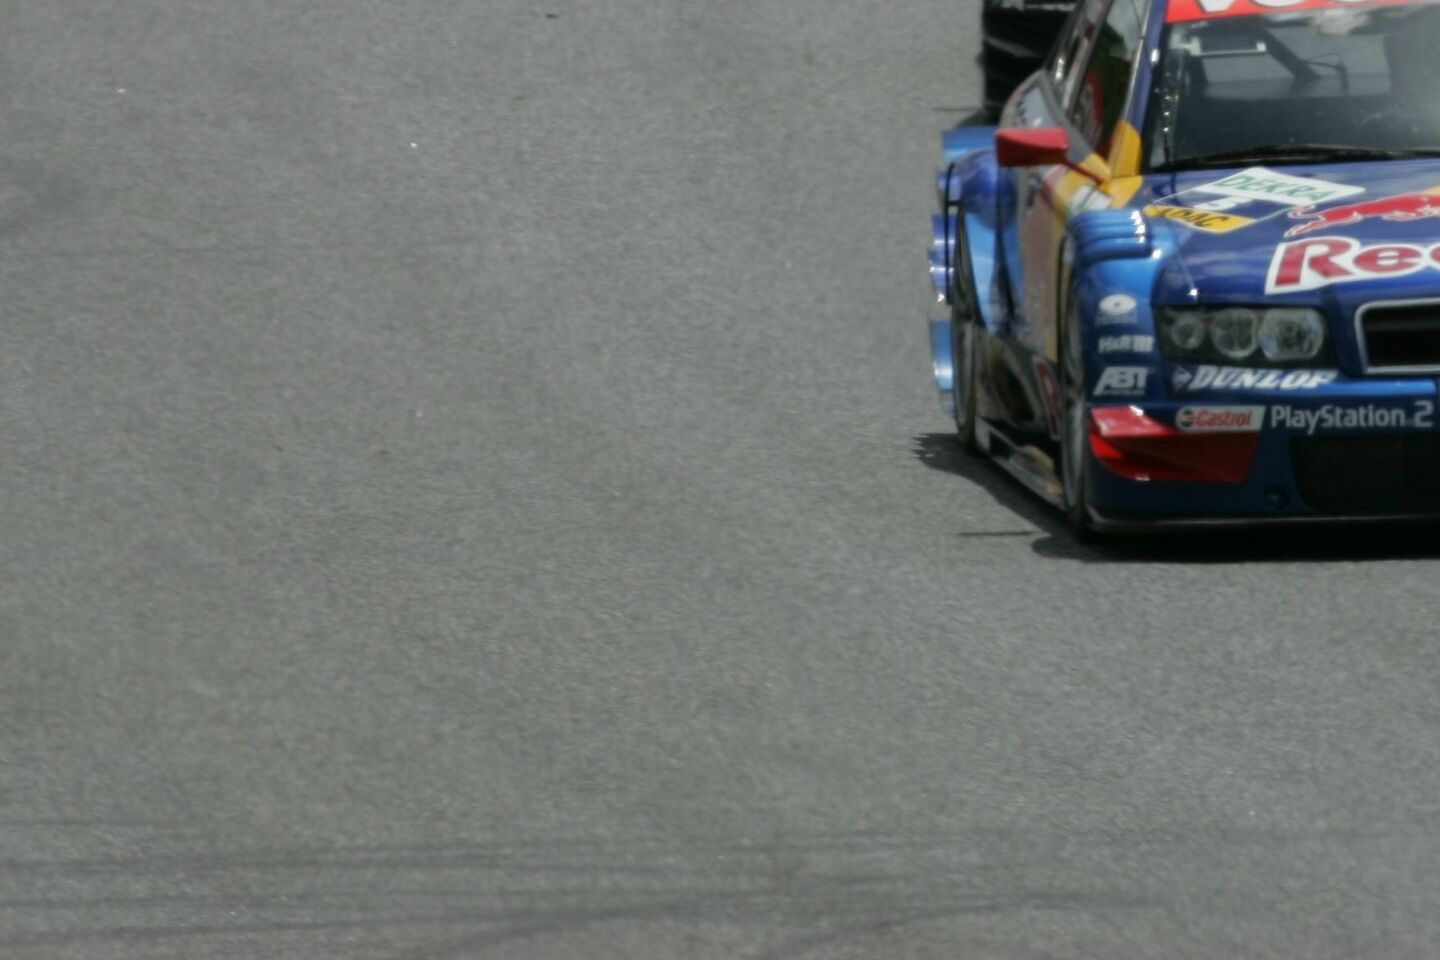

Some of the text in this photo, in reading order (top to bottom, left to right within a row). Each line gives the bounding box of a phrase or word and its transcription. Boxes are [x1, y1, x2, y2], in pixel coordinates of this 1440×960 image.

[1214, 175, 1337, 201] DEKRA
[1092, 366, 1150, 396] ABT
[1188, 365, 1339, 390] DUNLOP
[1192, 409, 1253, 430] Castrol
[1270, 402, 1403, 434] PlayStation
